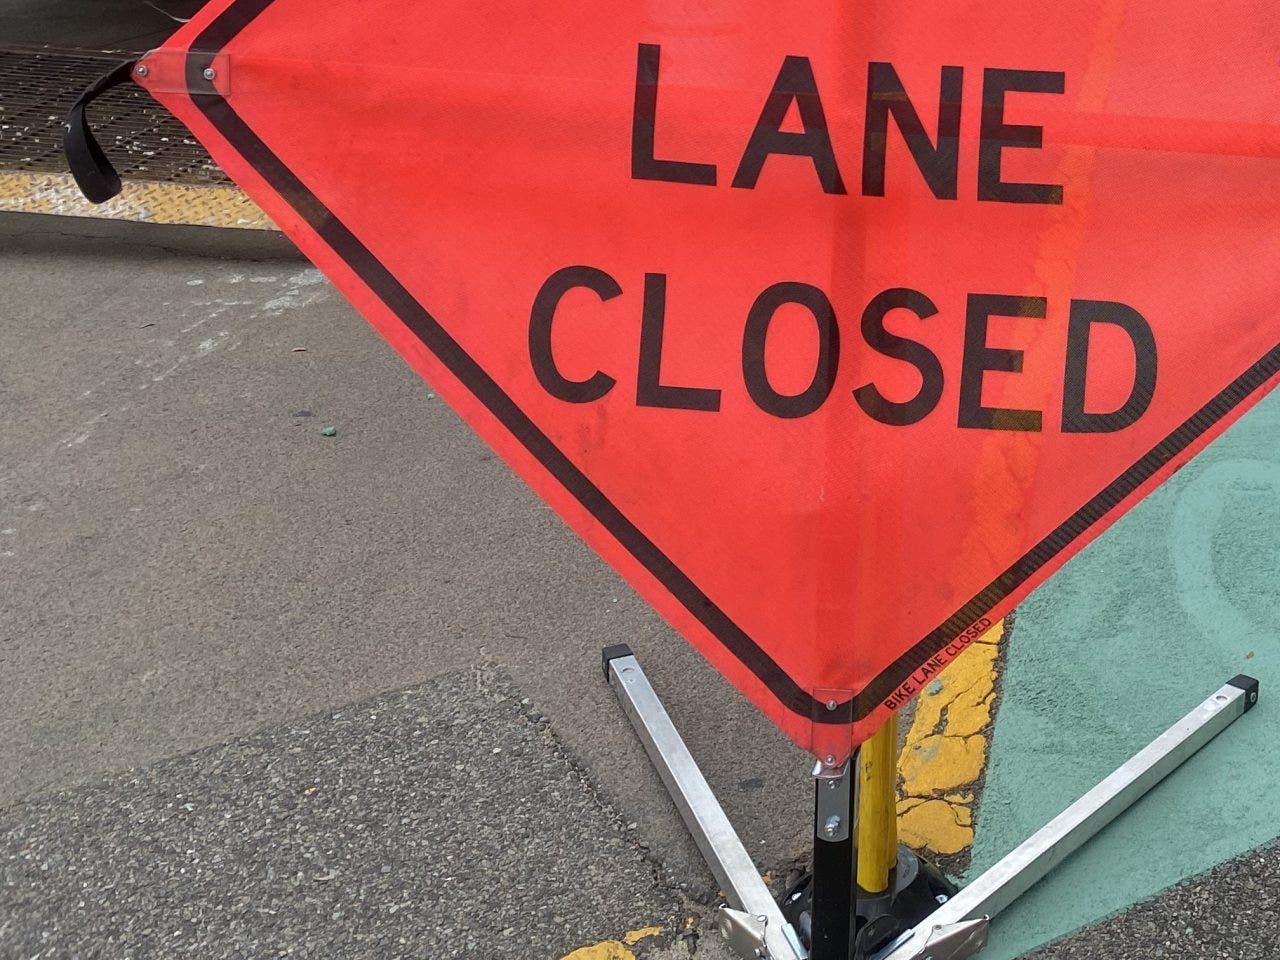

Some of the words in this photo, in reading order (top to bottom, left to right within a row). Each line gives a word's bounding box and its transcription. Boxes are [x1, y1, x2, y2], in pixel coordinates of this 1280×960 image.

[631, 42, 1065, 205] LANE
[528, 265, 1158, 434] CLOSED
[884, 681, 916, 710] BIKE
[912, 654, 948, 685] LANE
[945, 617, 992, 657] CLOSED
